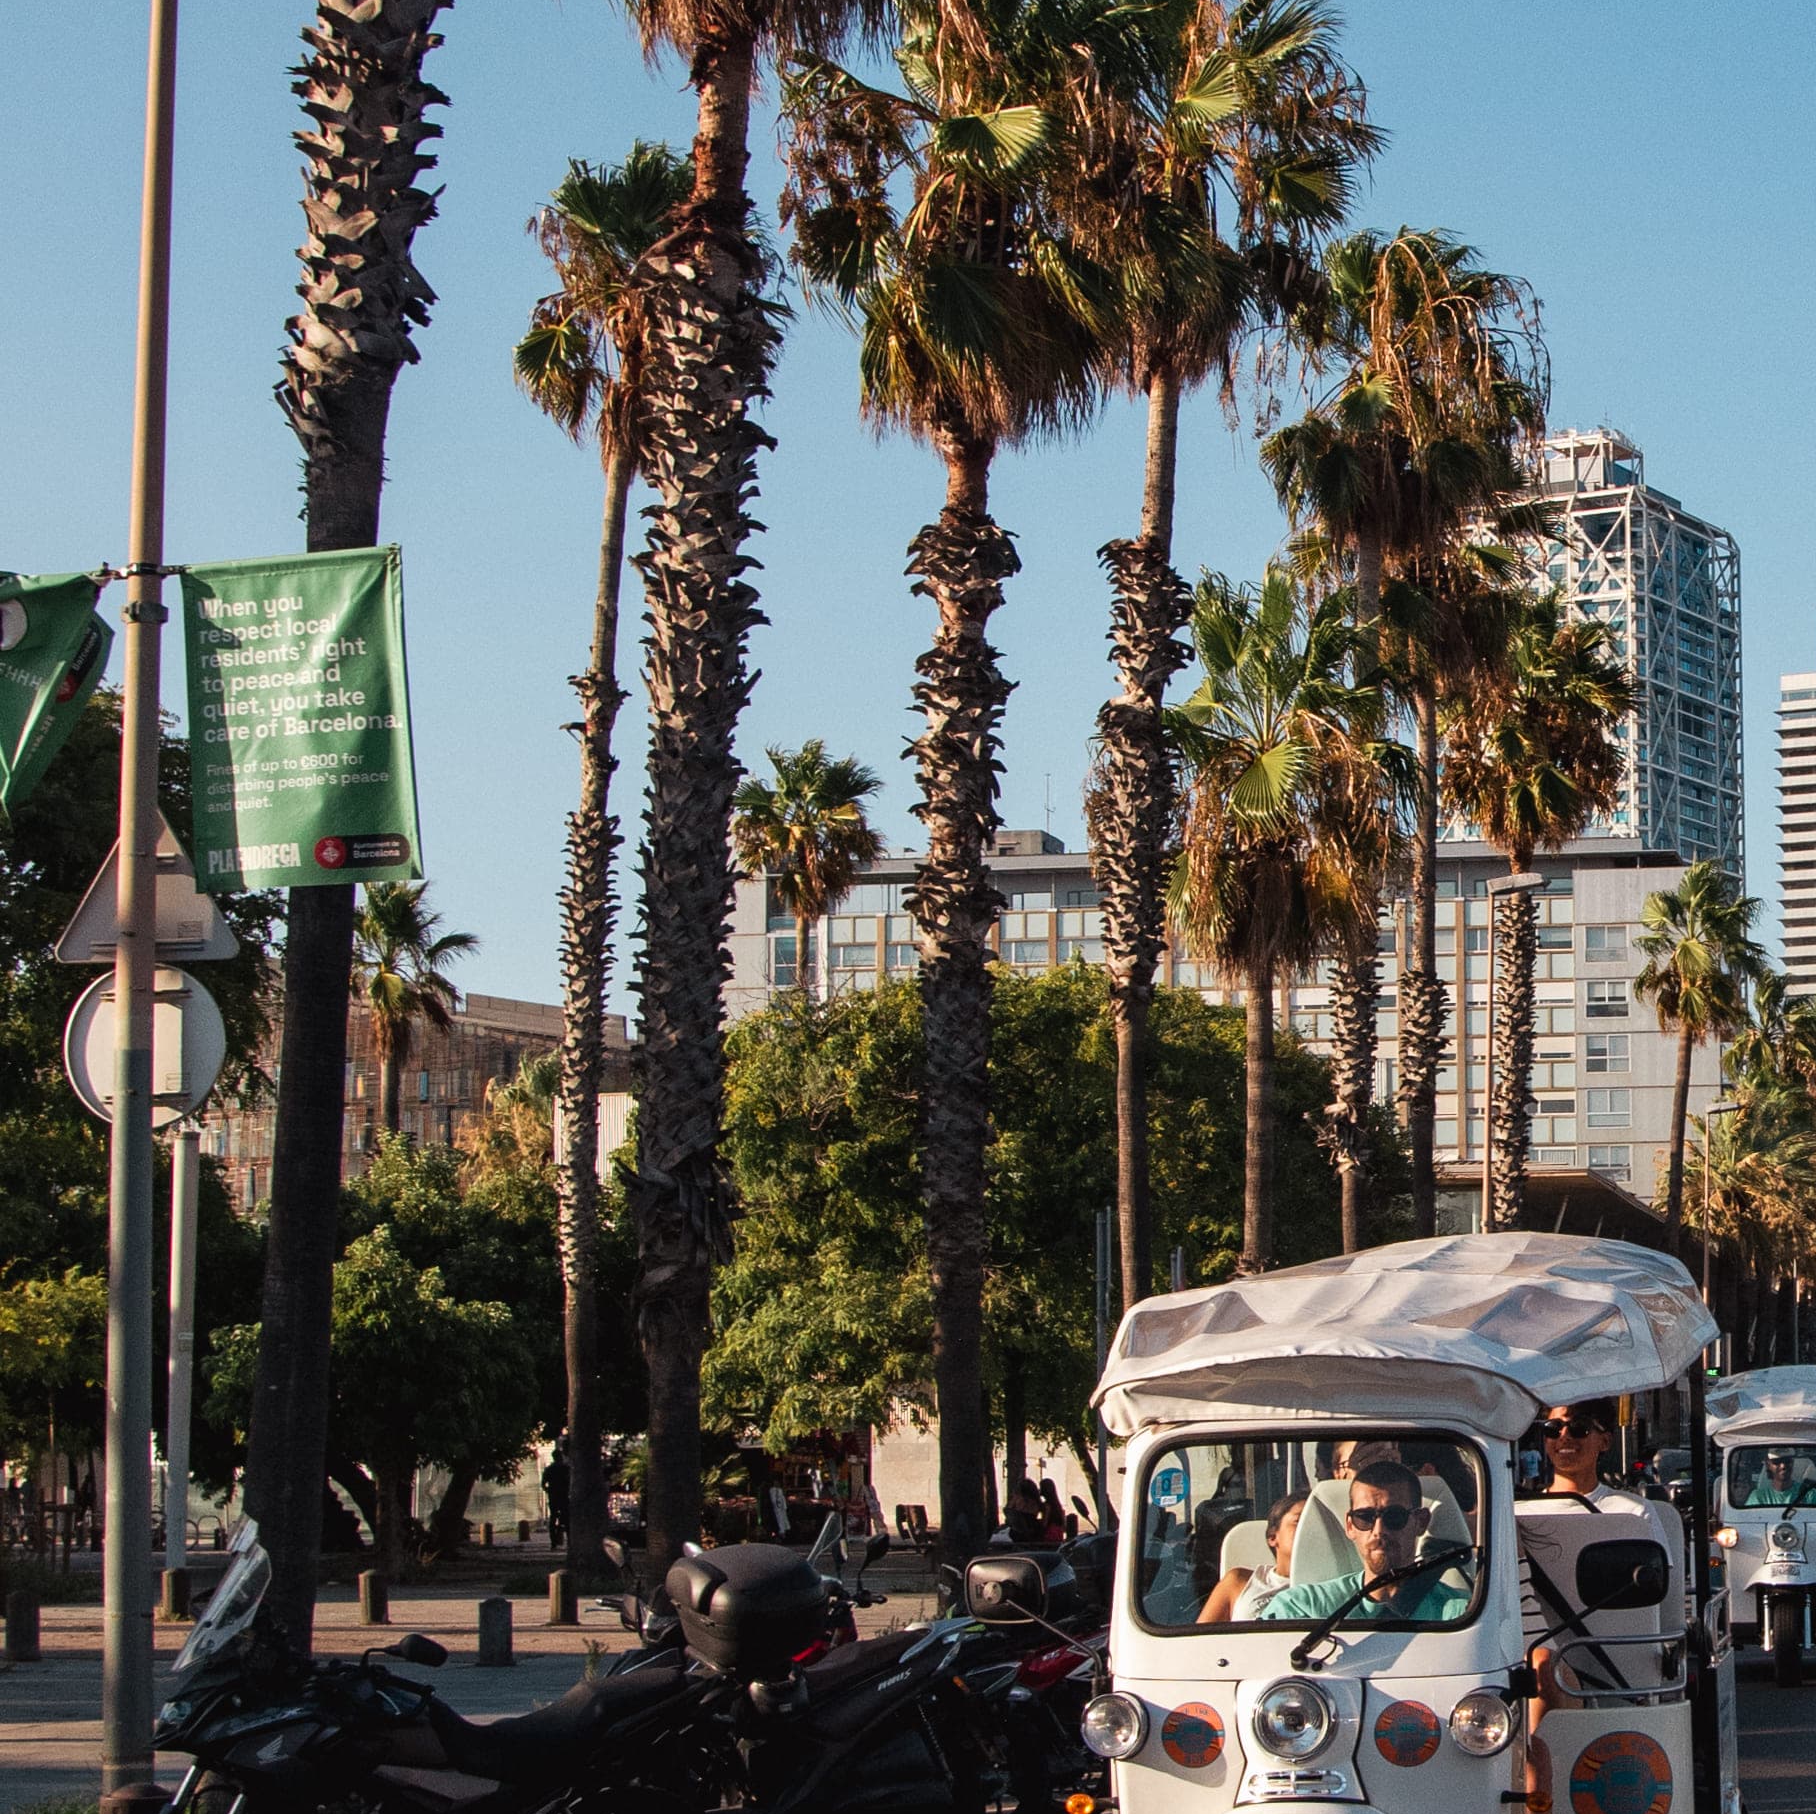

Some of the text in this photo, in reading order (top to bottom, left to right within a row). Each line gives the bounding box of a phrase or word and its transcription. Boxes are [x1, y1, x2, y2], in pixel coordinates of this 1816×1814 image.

[197, 596, 303, 620] When you
[200, 613, 337, 646] respect local
[311, 637, 367, 661] right
[201, 664, 341, 695] to peace and
[203, 687, 366, 722] quiet, you take
[204, 712, 403, 743] care of Barcelona.
[206, 752, 364, 777] Fines of up to €600 for
[207, 771, 390, 795] disturbing people's peace
[207, 796, 273, 813] and quiet.
[207, 849, 235, 874] PLA
[353, 849, 401, 859] Barcelona
